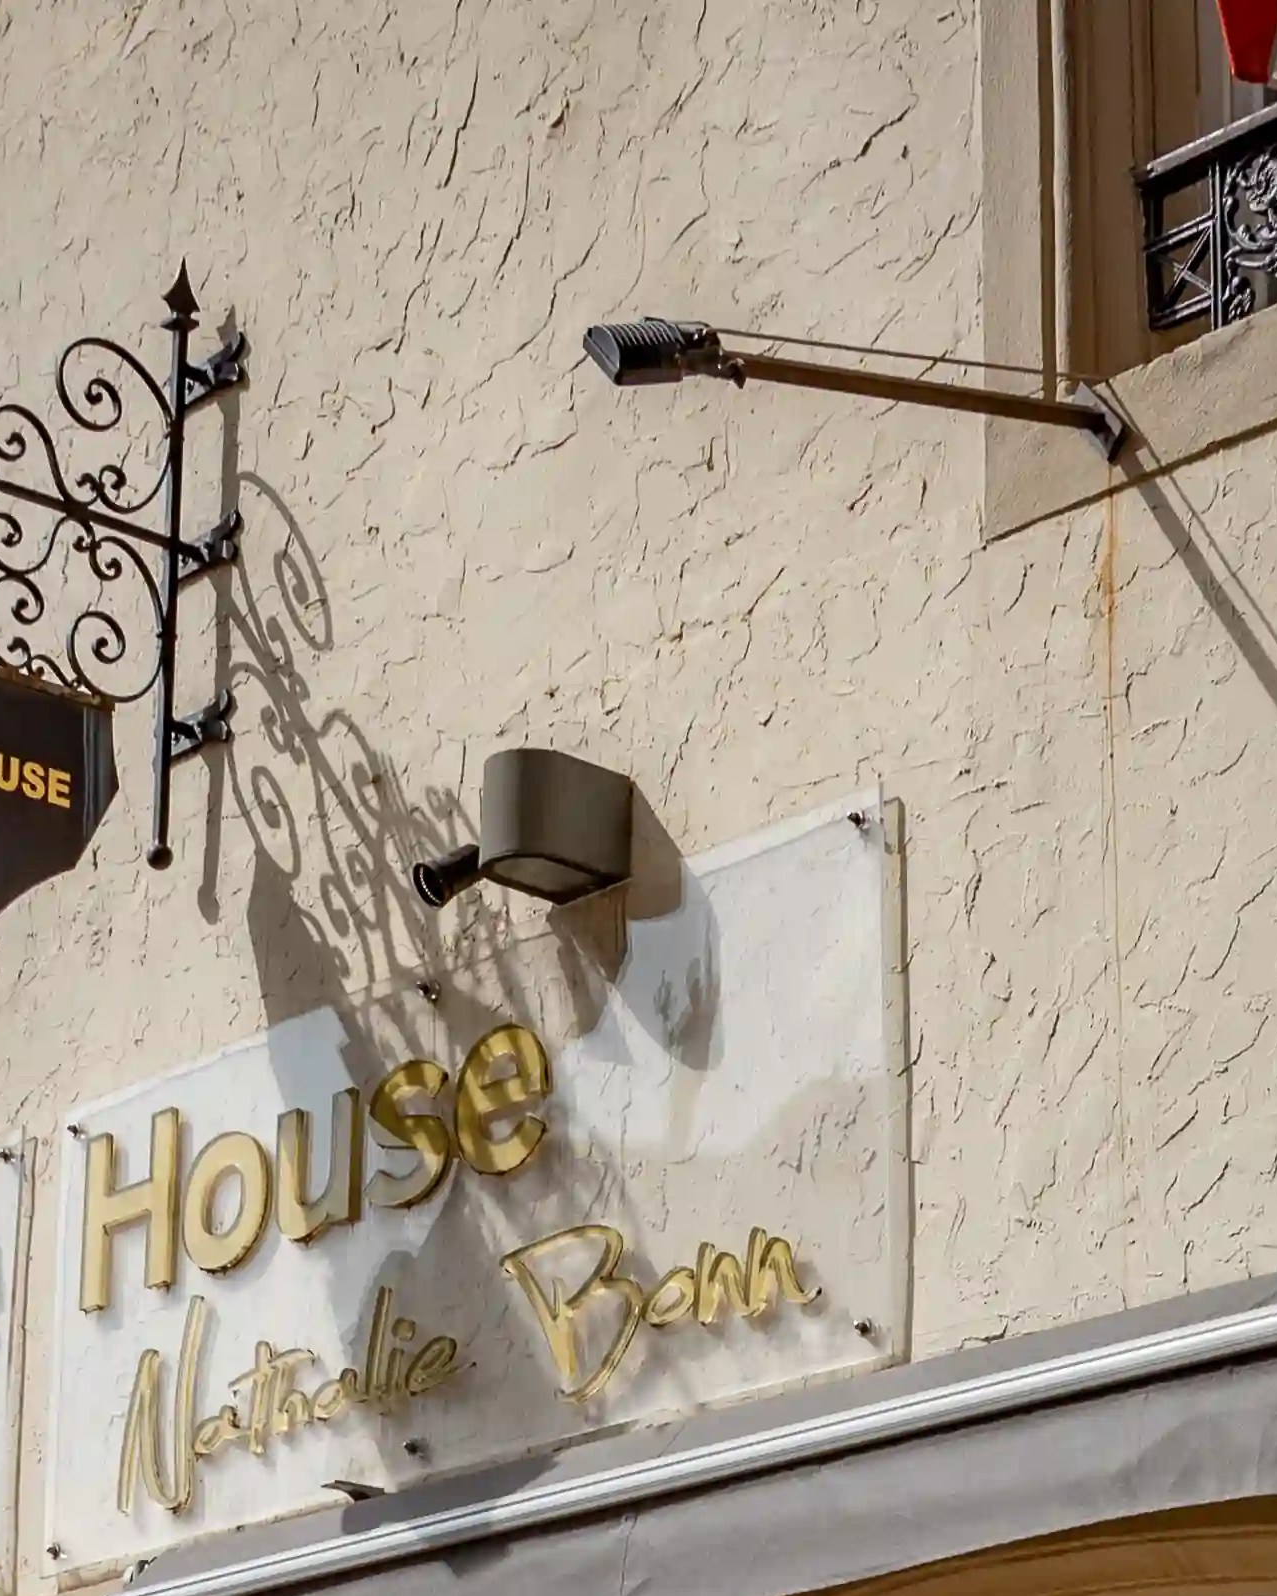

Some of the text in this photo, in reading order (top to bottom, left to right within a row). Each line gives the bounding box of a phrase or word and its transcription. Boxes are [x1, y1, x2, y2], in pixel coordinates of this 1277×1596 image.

[79, 1022, 553, 1314] House
[117, 1223, 823, 1517] Nathalie Bonn
